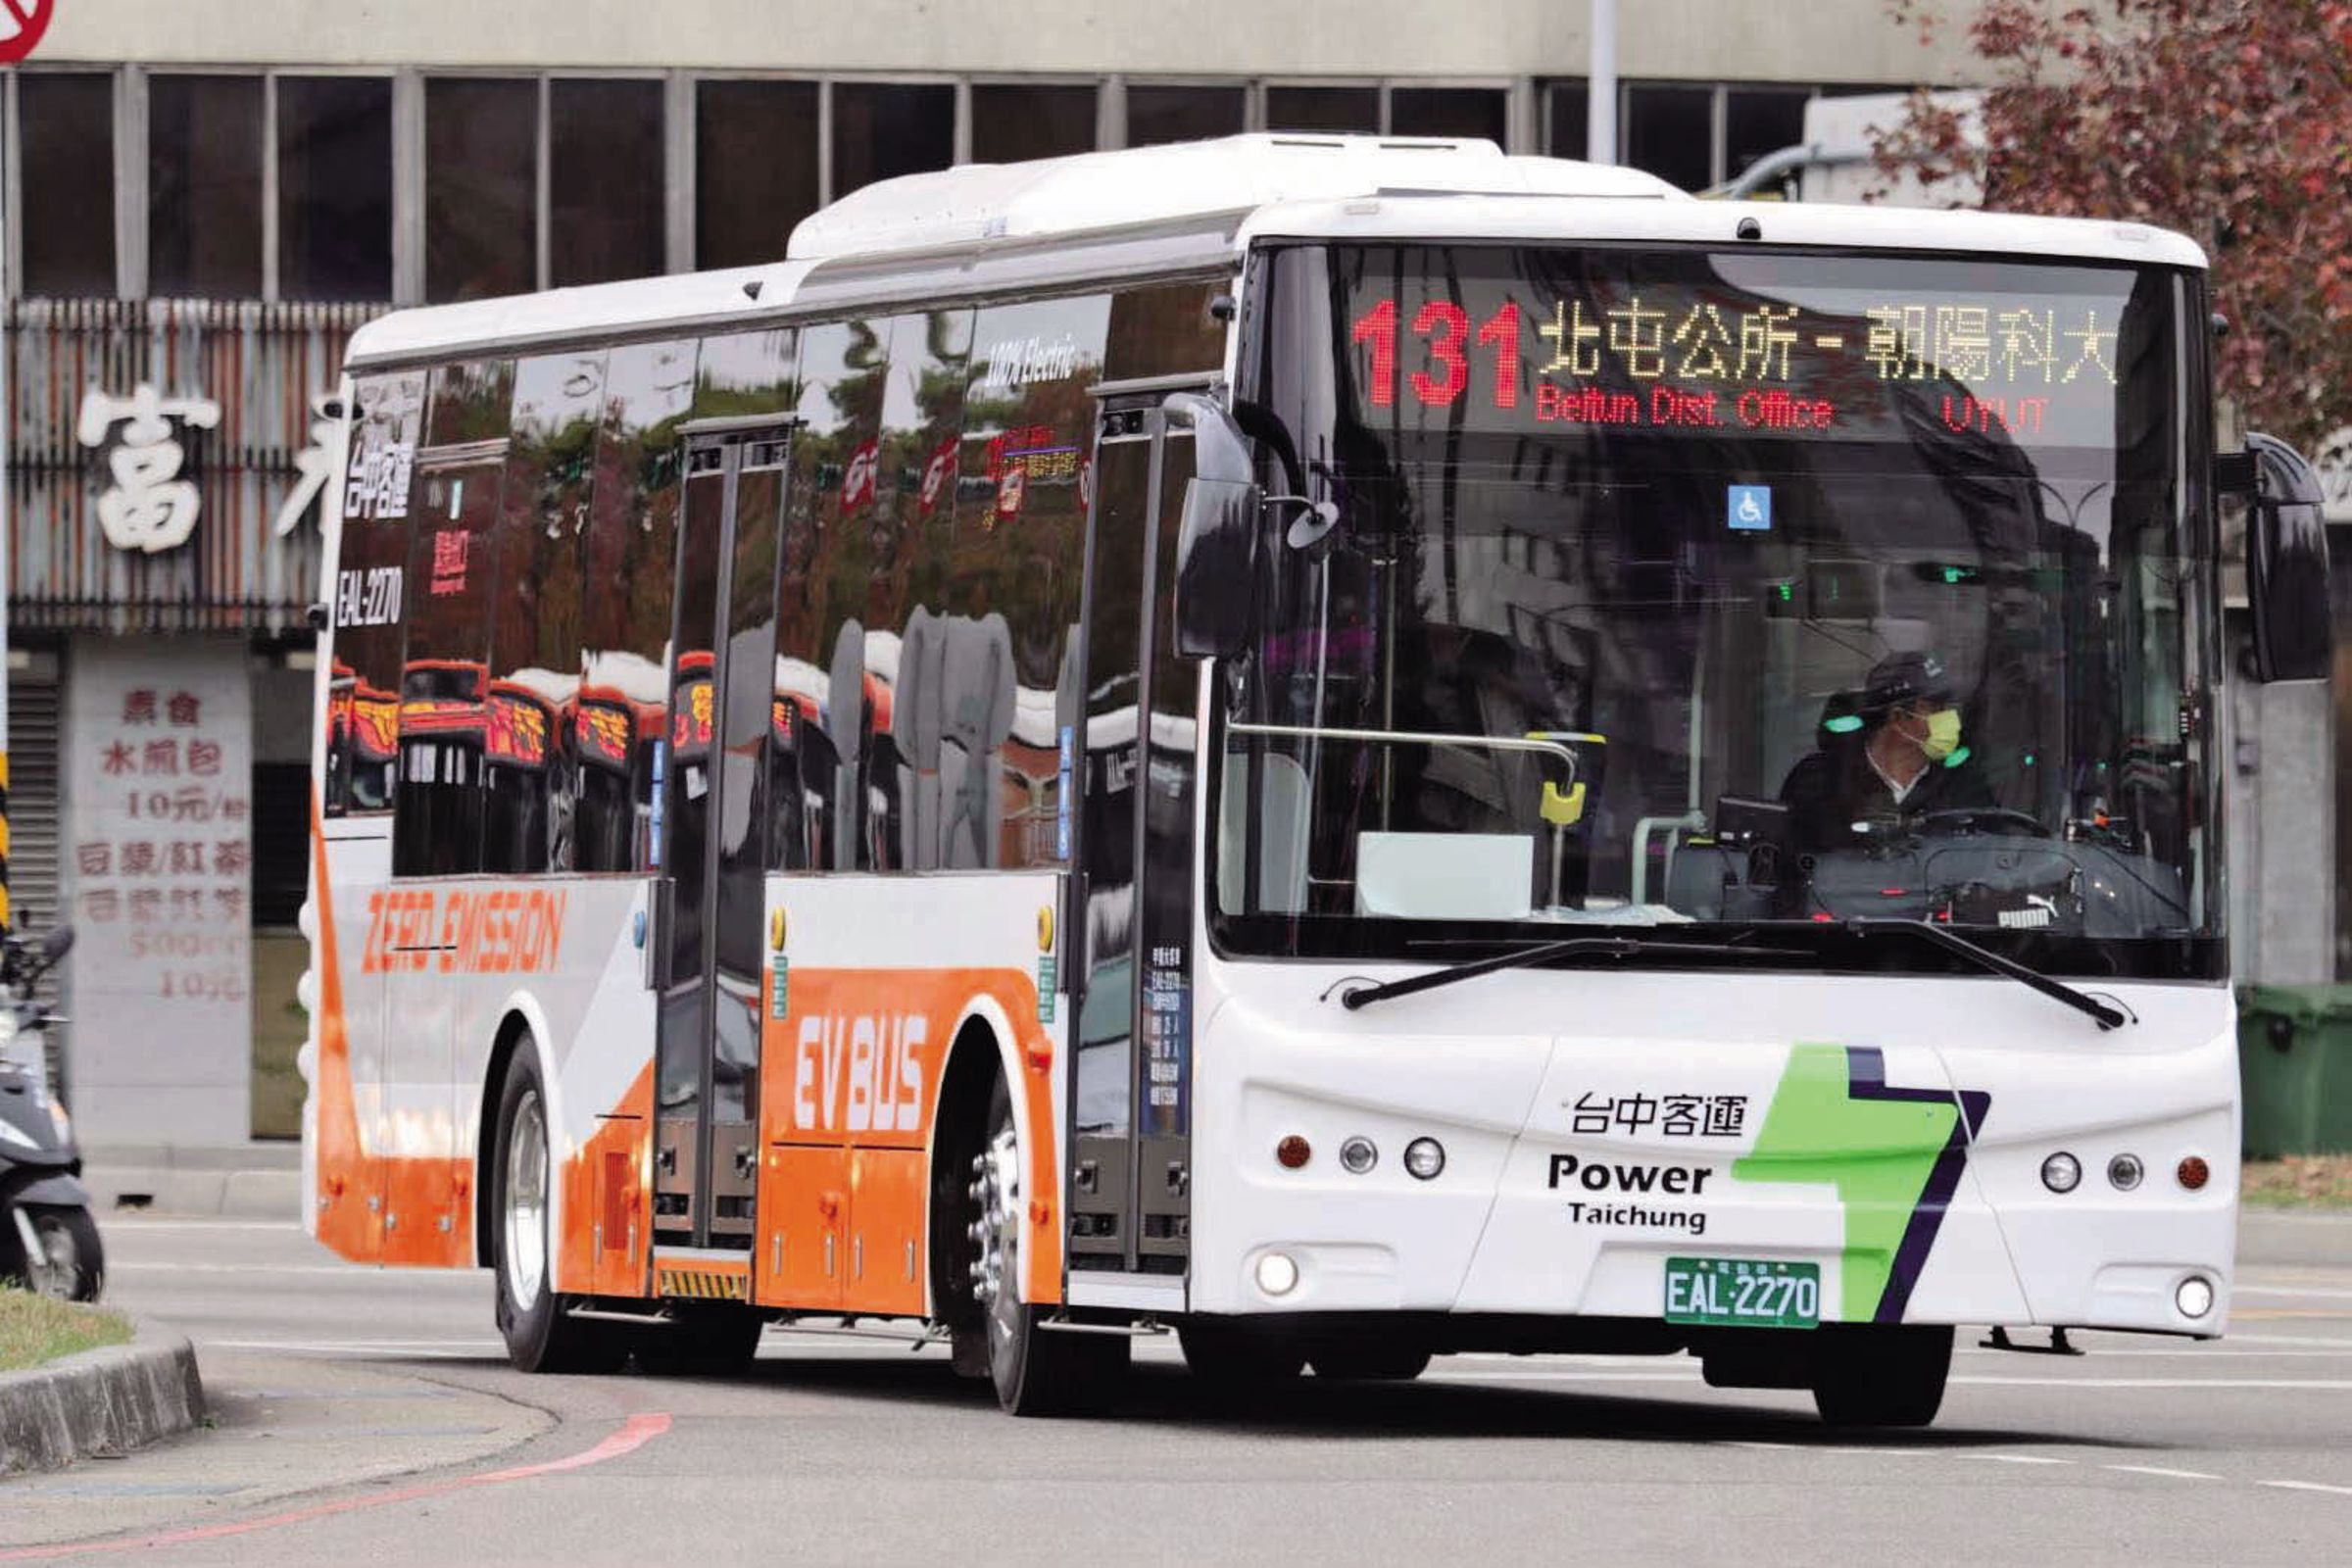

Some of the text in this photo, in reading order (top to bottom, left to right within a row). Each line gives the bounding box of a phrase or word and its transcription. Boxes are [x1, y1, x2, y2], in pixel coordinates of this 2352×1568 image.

[985, 334, 1075, 387] 100% Electric
[1352, 299, 1519, 410] 131
[1537, 383, 1639, 423] Beitun
[1650, 385, 1726, 426] Dist.
[1736, 389, 1837, 429] Office
[345, 440, 414, 518] 台中客運
[337, 565, 403, 627] EAL-2270
[121, 689, 201, 727] 素食
[101, 738, 222, 776] 水煎包
[362, 888, 566, 974] ZERO EMISSION
[794, 1013, 928, 1131] EV BUS
[1572, 1091, 1748, 1137] 台中客運
[1547, 1152, 1713, 1195] Power
[1568, 1201, 1707, 1235] Taichung
